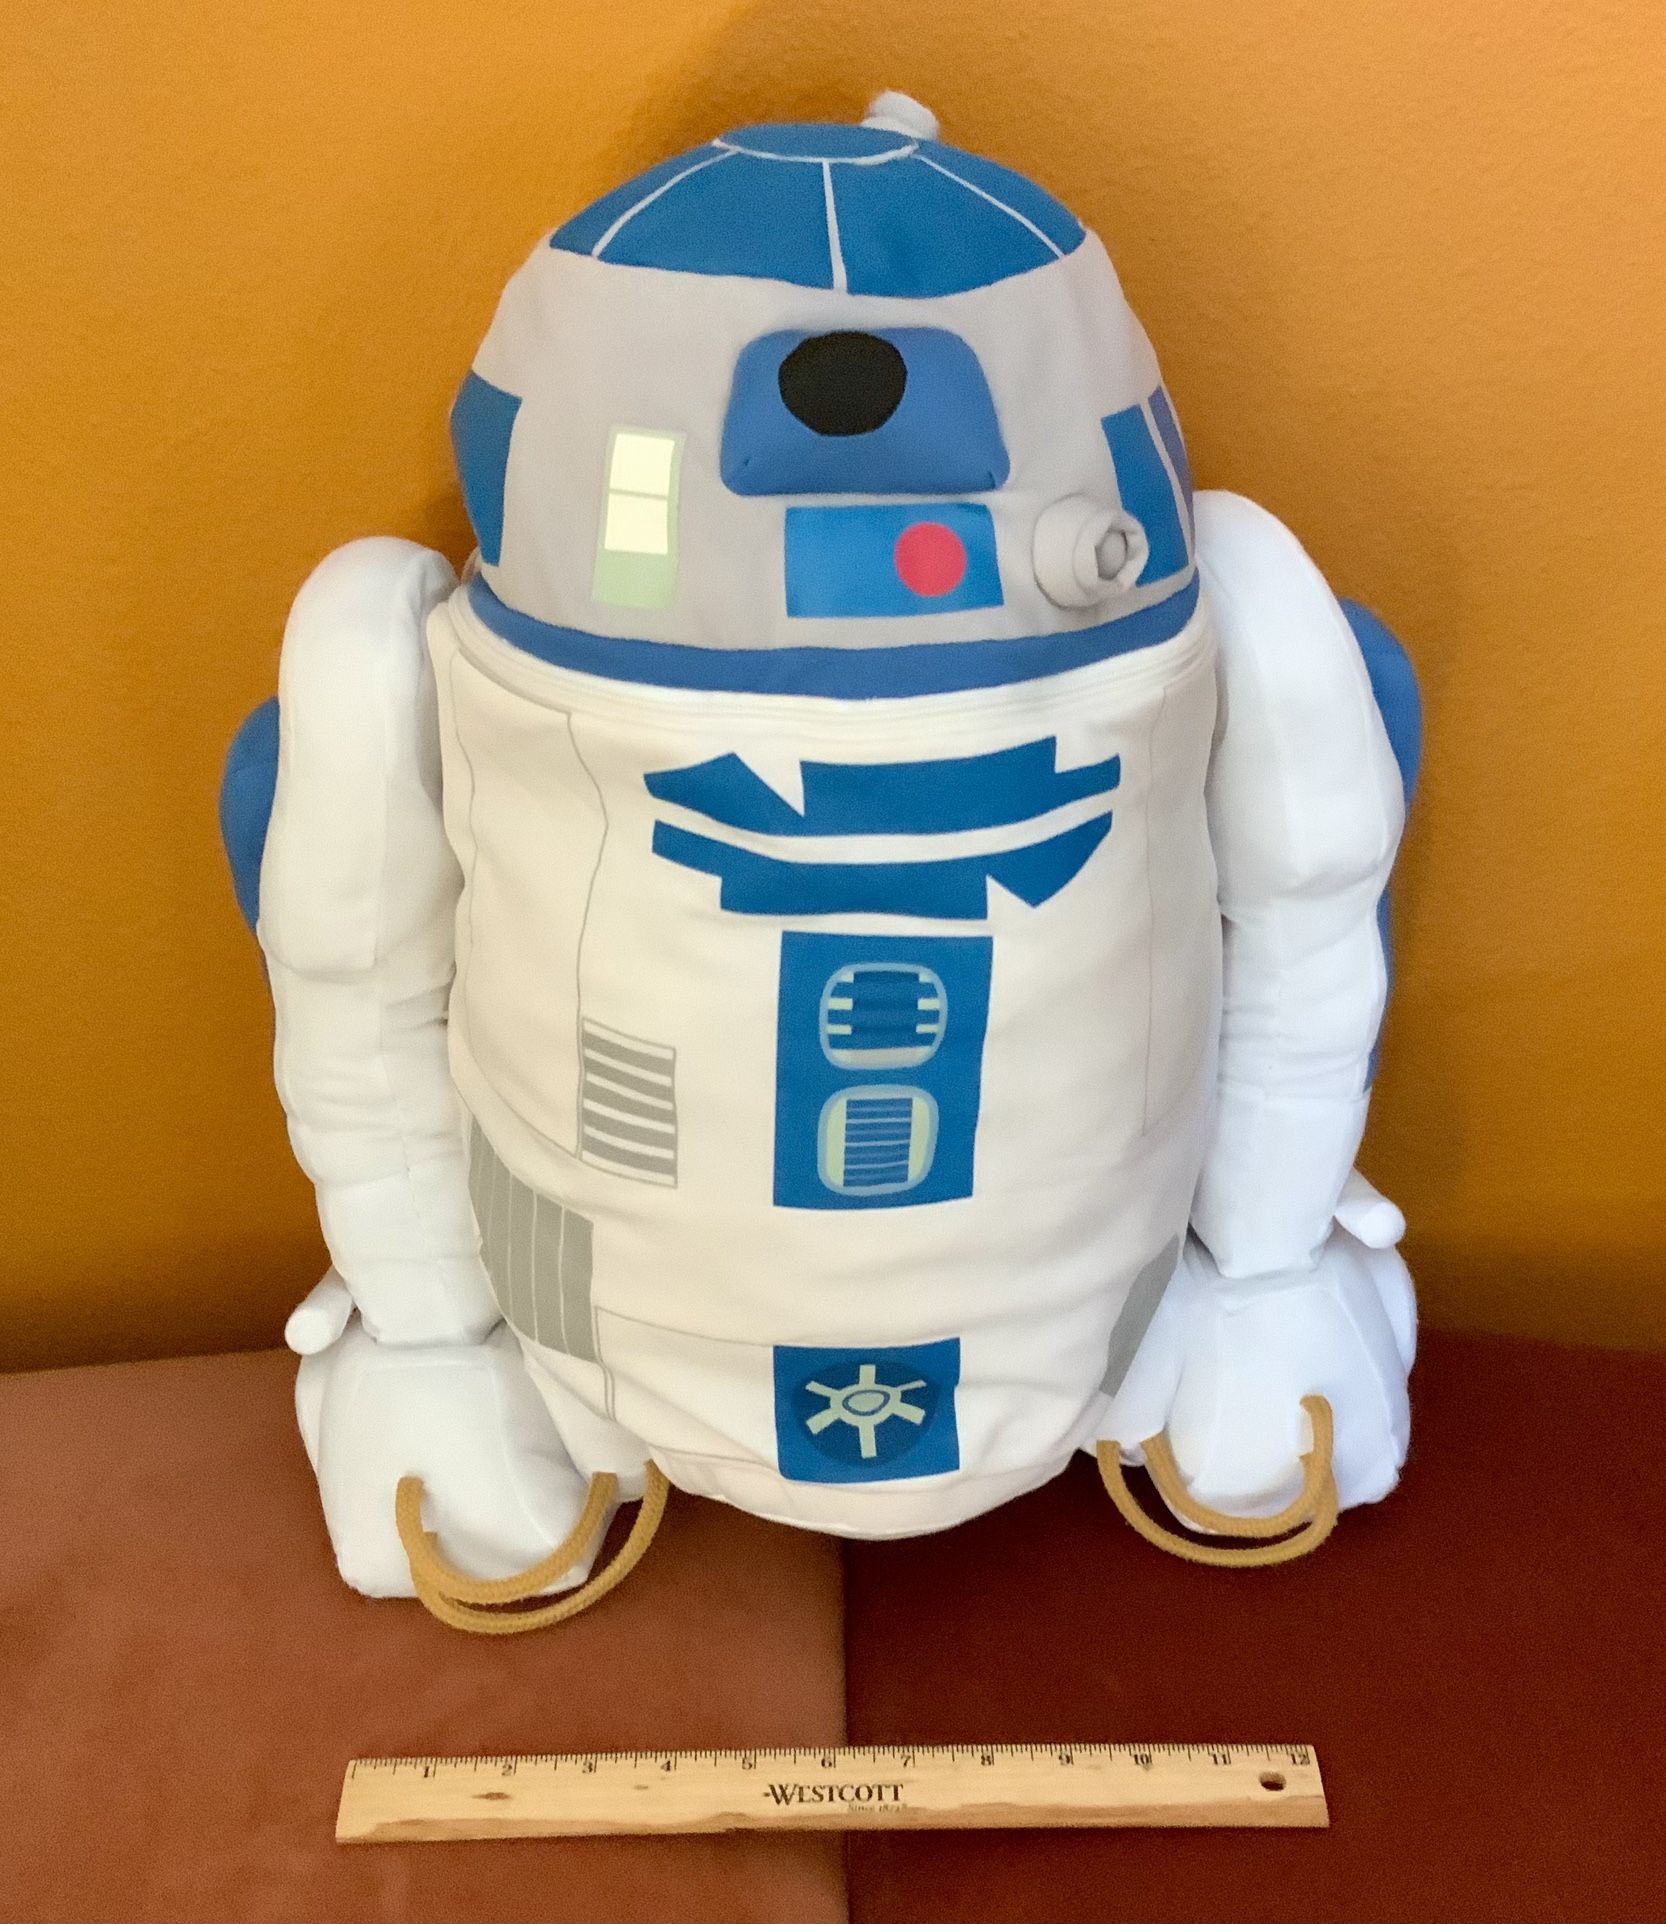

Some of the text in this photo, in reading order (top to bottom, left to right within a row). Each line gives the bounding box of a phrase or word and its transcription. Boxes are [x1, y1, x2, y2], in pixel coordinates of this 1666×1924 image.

[501, 1763, 512, 1777] 2
[582, 1761, 593, 1774] 3
[661, 1760, 672, 1772] 4
[742, 1757, 752, 1770] 5
[821, 1756, 832, 1769] 6
[900, 1755, 911, 1768] 7
[980, 1755, 991, 1767] 8
[1058, 1753, 1070, 1766] 9
[1133, 1753, 1149, 1766] 10
[1212, 1753, 1229, 1766] 11
[1290, 1753, 1308, 1766] 12
[768, 1783, 904, 1806] WESTCOTT
